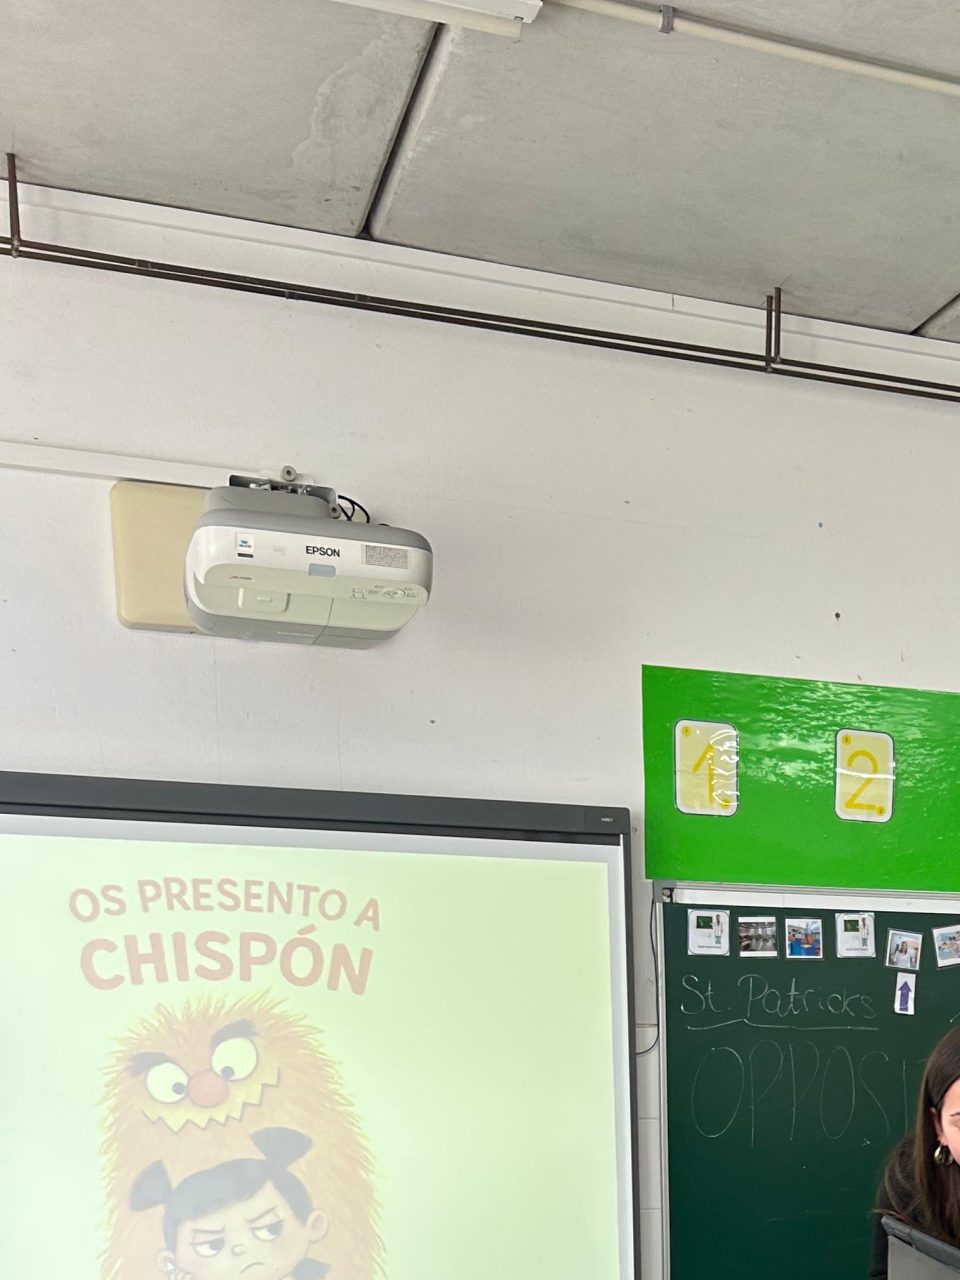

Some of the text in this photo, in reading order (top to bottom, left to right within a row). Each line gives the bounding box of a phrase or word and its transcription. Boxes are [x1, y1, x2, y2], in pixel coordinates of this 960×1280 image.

[306, 545, 341, 557] EPSON
[692, 742, 714, 804] 1
[845, 750, 878, 809] 2
[68, 876, 382, 932] OS PRESENTO A
[79, 924, 373, 995] CHISPÓN
[691, 1039, 928, 1148] OPPOSI
